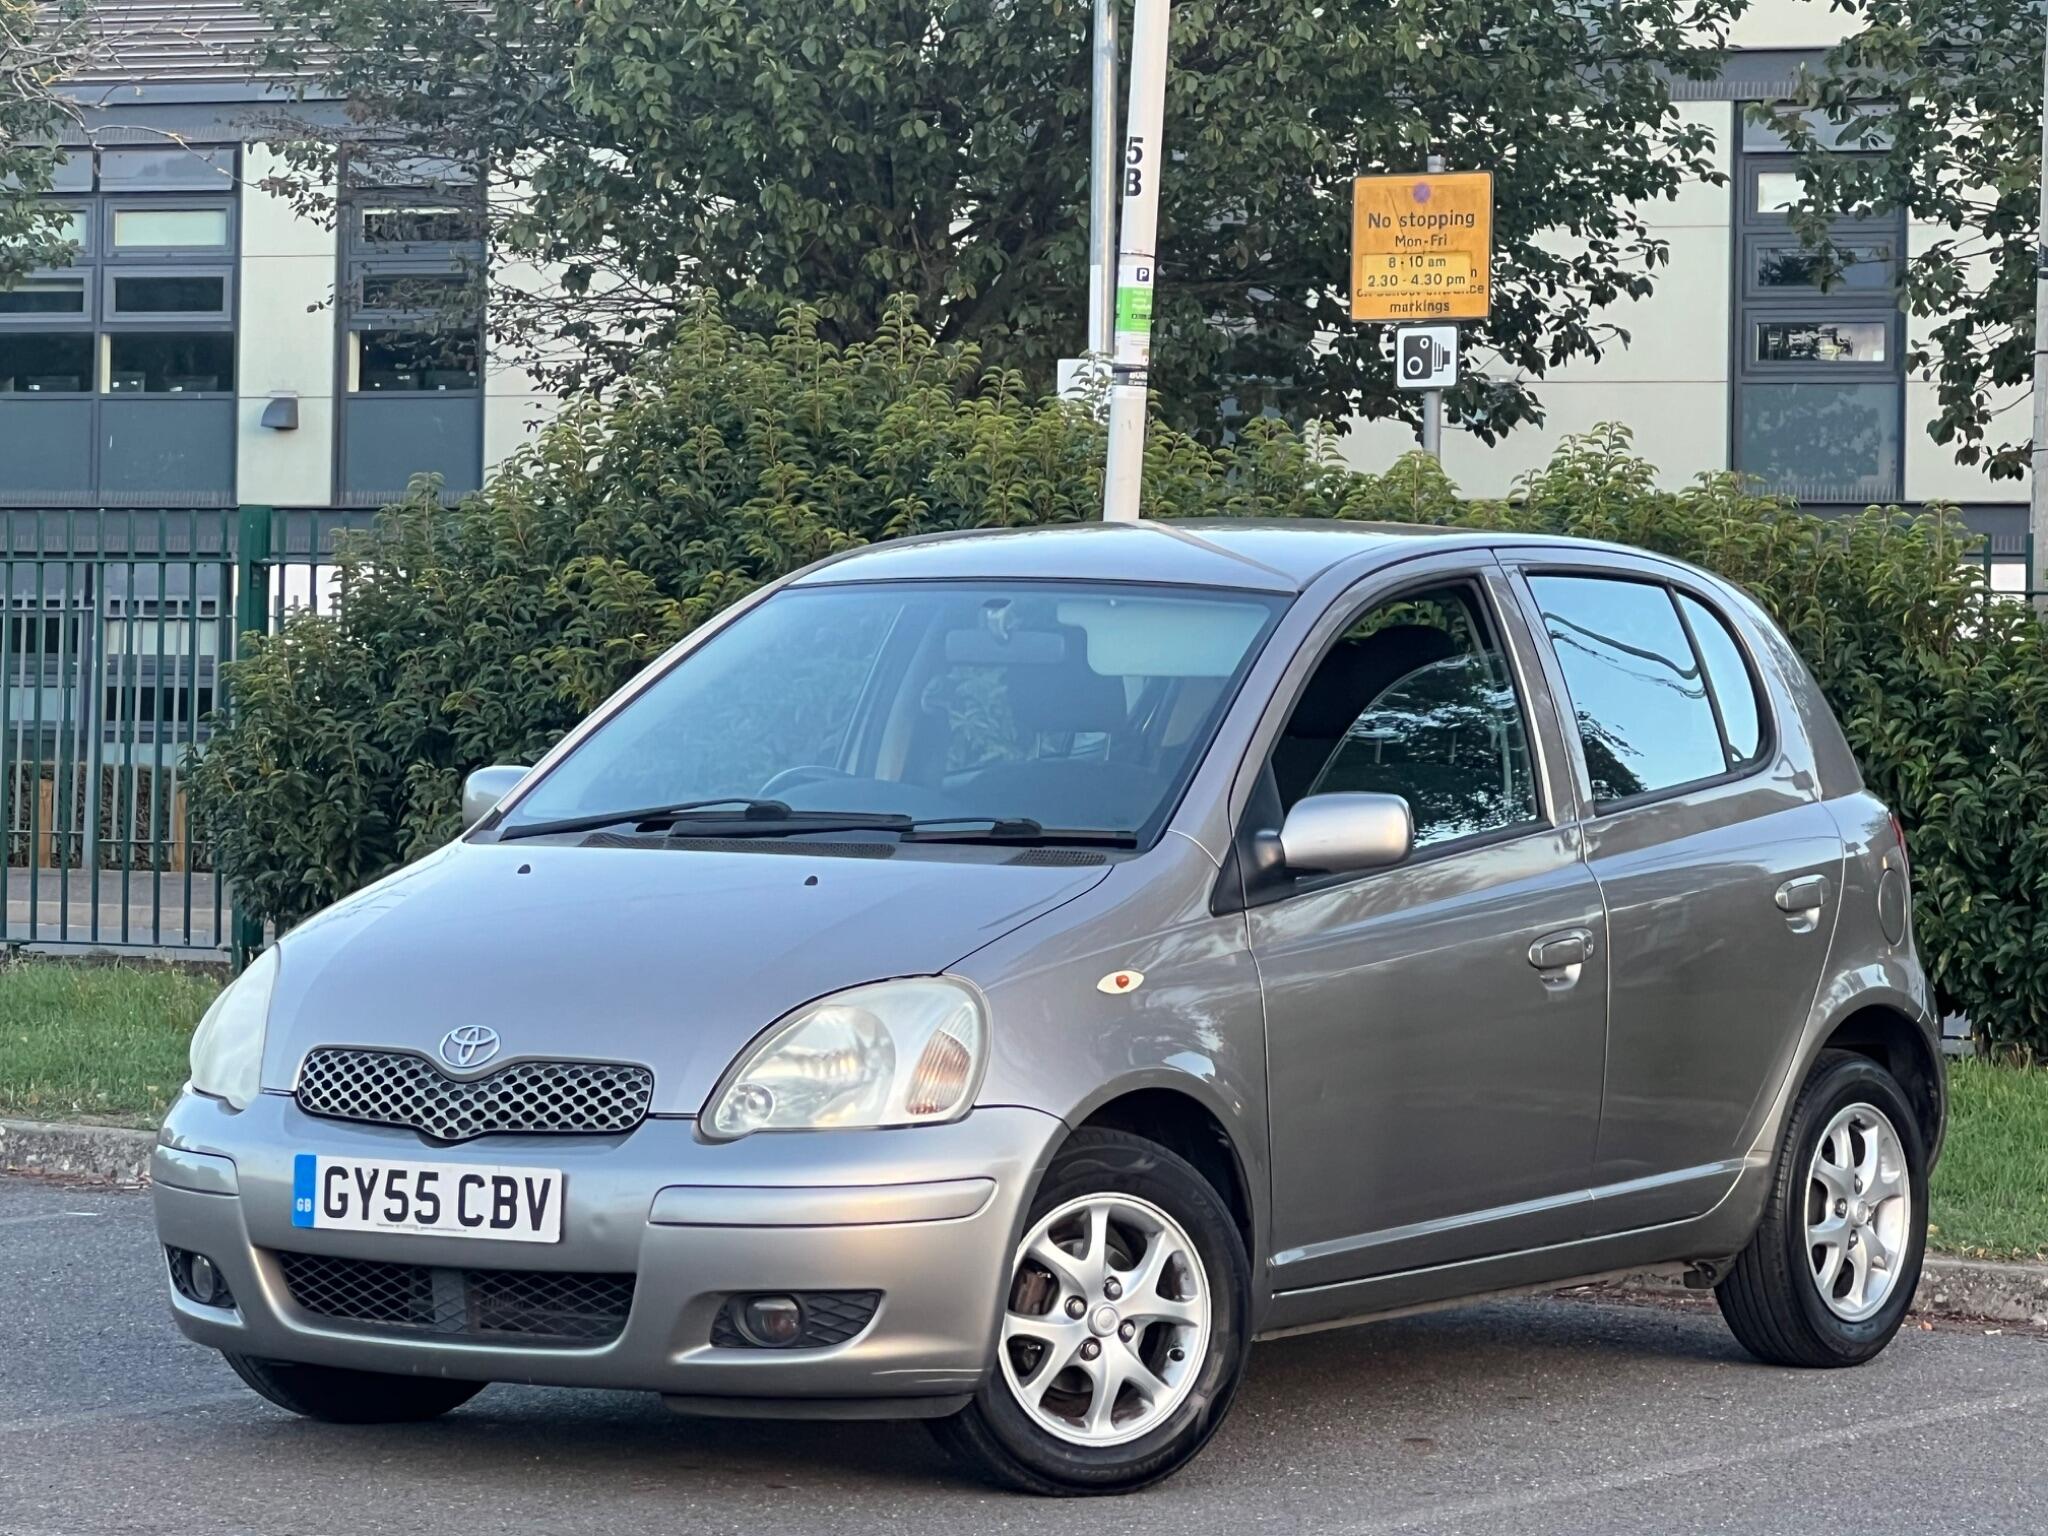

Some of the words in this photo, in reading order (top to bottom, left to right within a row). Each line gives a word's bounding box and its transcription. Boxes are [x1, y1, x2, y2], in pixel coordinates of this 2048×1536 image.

[1368, 212, 1391, 229] No
[1399, 210, 1475, 229] stopping
[1388, 257, 1395, 268] 8
[1409, 256, 1423, 267] 10
[1428, 257, 1446, 267] am
[1368, 275, 1397, 287] 2.30
[1411, 274, 1442, 285] 4.30
[1446, 276, 1466, 287] pm
[1390, 300, 1450, 314] markings
[296, 1198, 312, 1212] GB
[323, 1165, 440, 1225] GY55
[457, 1173, 552, 1231] CBV
